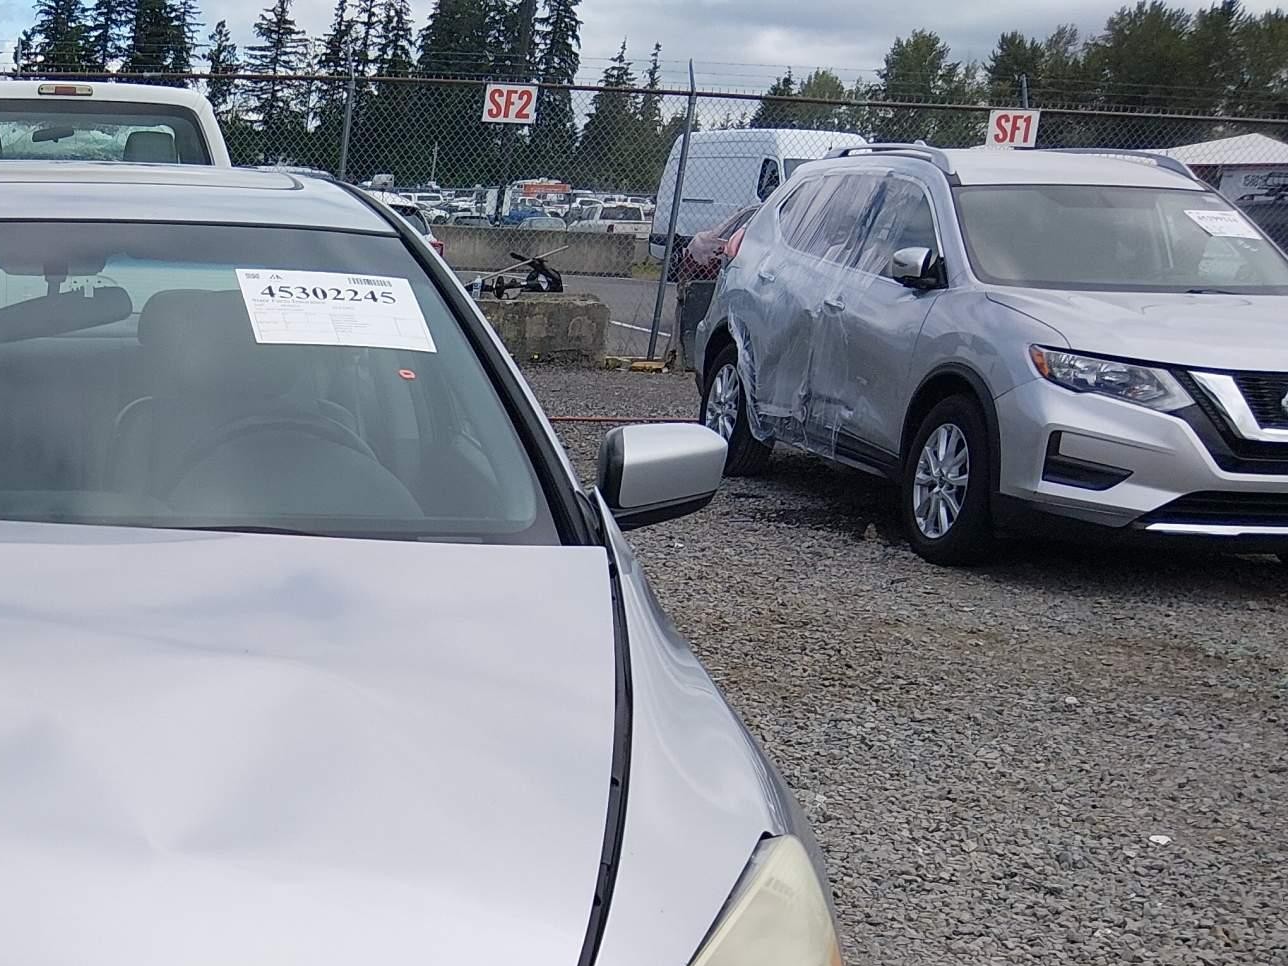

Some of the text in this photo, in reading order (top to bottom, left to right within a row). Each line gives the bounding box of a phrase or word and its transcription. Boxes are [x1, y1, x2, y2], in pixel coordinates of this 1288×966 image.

[489, 91, 533, 118] SF2
[996, 116, 1031, 142] SF1
[260, 285, 396, 304] 45302245
